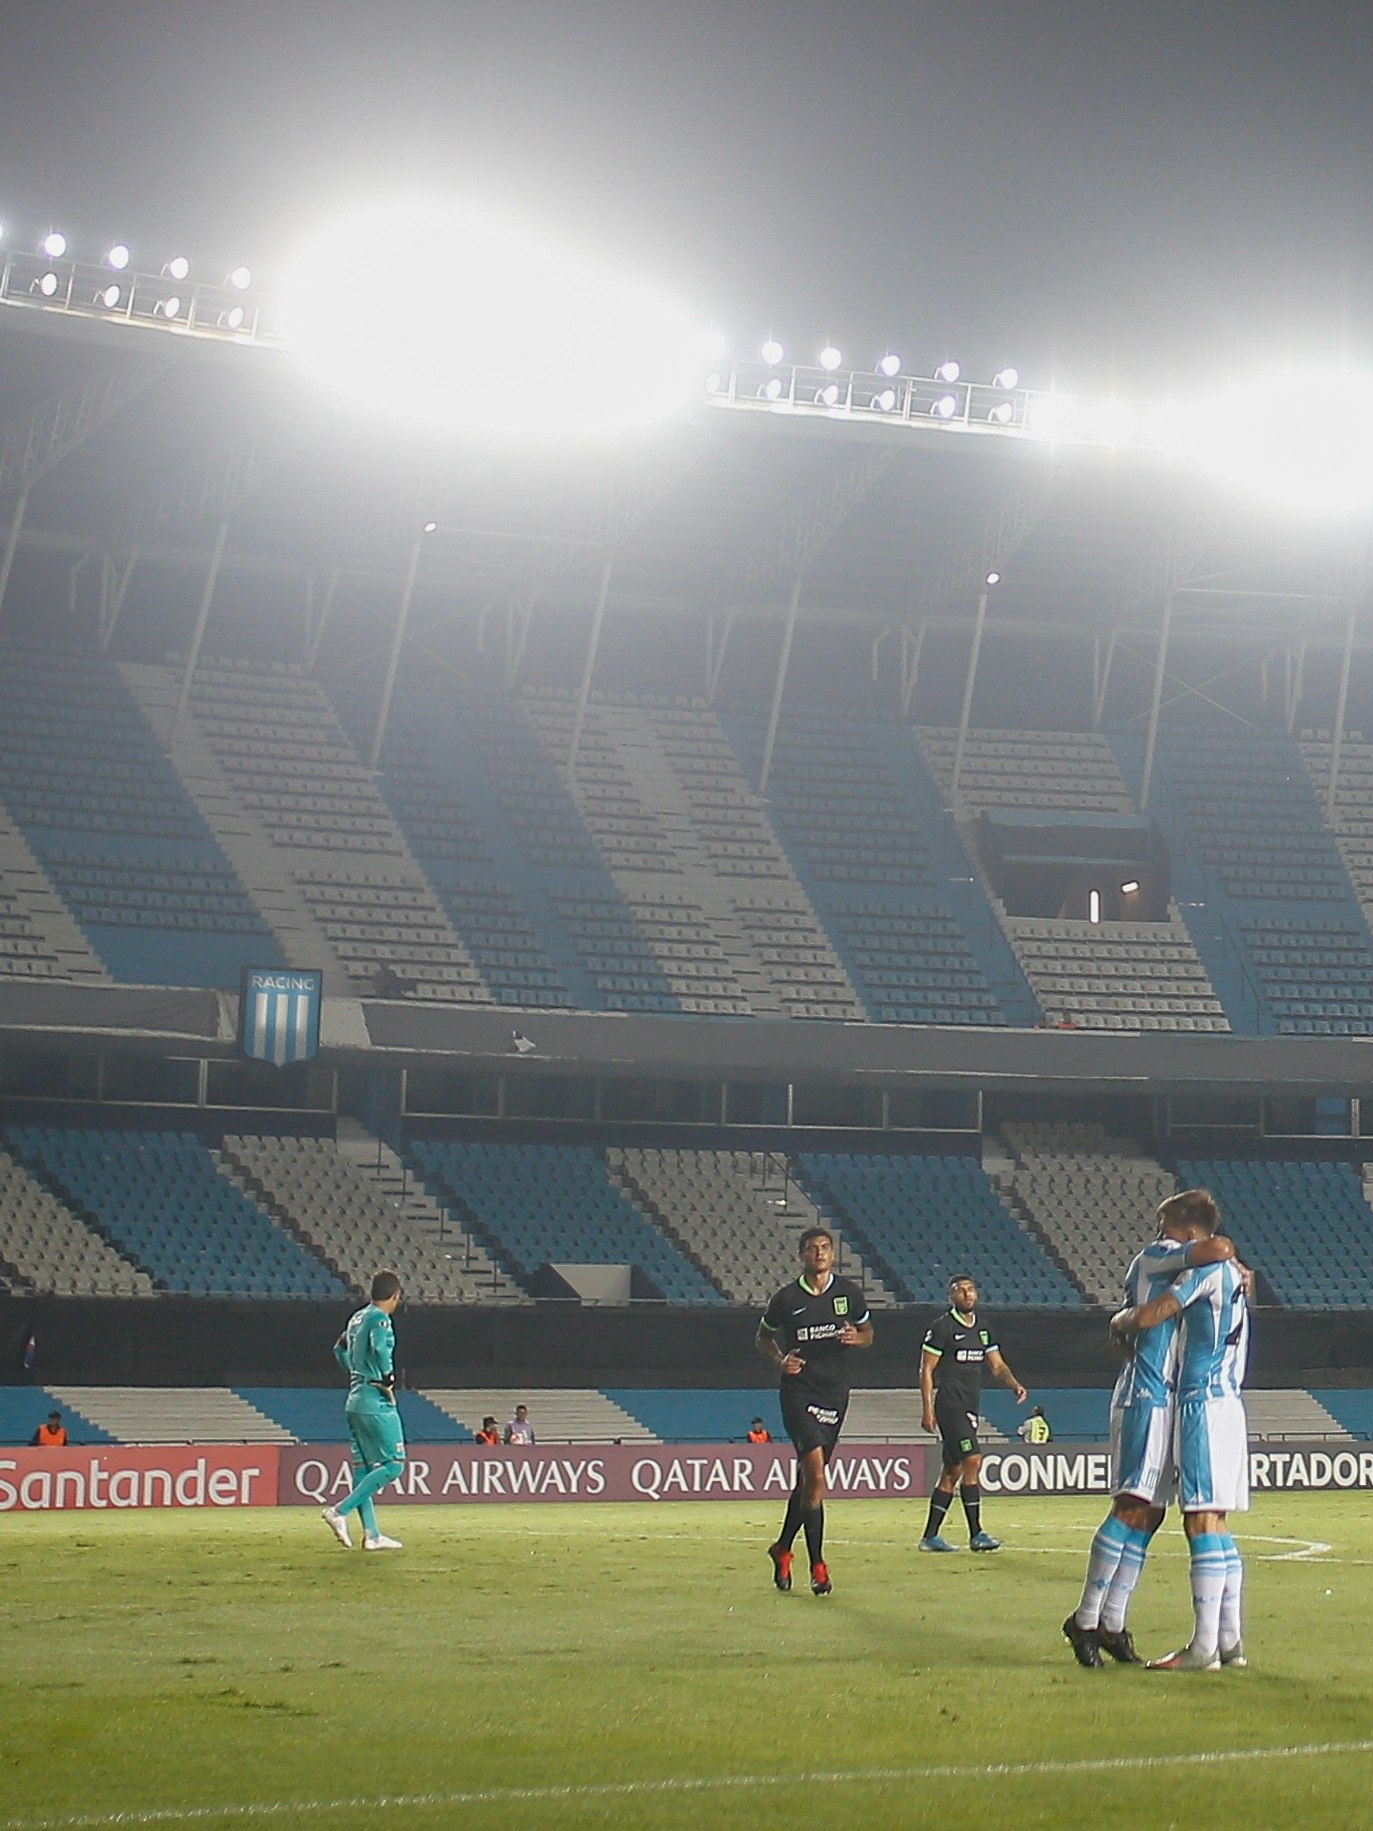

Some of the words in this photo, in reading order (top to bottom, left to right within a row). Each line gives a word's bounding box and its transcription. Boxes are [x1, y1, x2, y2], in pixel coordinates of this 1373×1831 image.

[252, 974, 315, 991] RACING
[0, 1458, 261, 1512] Santander
[295, 1459, 433, 1503] QAAR
[442, 1460, 606, 1494] AIRWAYS
[631, 1458, 754, 1500] QATAR
[764, 1458, 911, 1491] AIWAYS
[979, 1454, 1112, 1491] CONME
